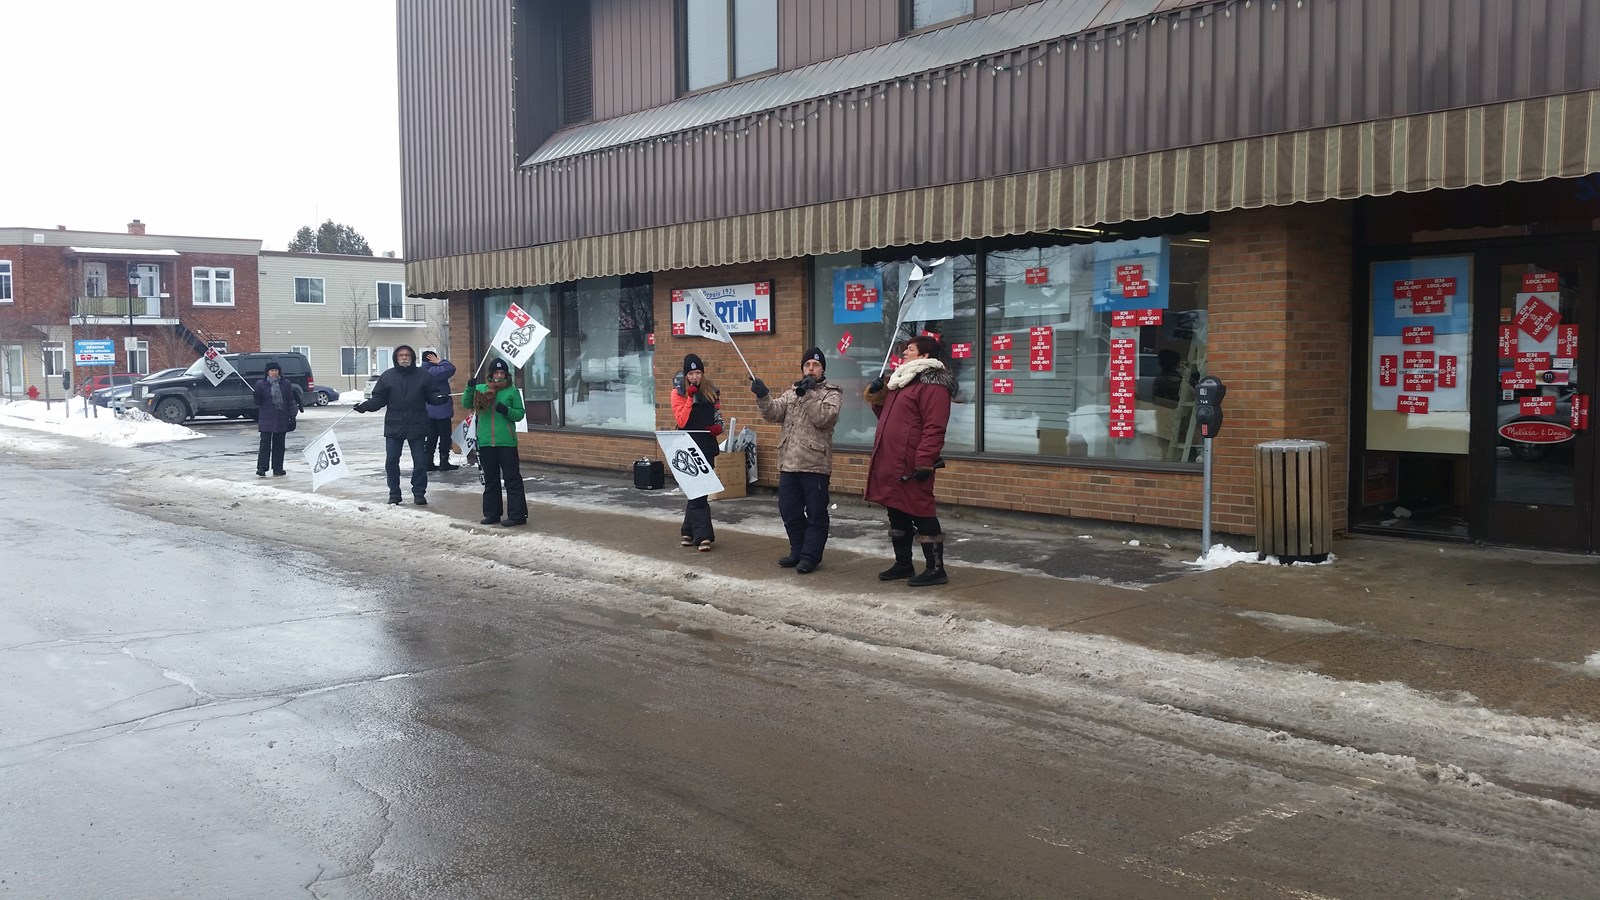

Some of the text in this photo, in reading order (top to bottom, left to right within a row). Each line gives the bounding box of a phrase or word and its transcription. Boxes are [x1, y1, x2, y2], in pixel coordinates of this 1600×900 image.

[703, 291, 720, 299] Depuis
[1518, 301, 1538, 325] LOCK-OUT
[1520, 305, 1529, 315] EN
[699, 318, 718, 334] CSN
[1533, 312, 1553, 335] LOCK-OUT
[1534, 316, 1544, 326] EN
[1499, 337, 1504, 347] EN
[1572, 336, 1577, 347] EN
[500, 340, 521, 359] CSN
[1381, 366, 1384, 375] EN
[1451, 367, 1456, 377] EN
[1506, 426, 1539, 436] Melissa
[1547, 429, 1566, 438] Doug
[325, 443, 341, 466] CSN
[687, 447, 710, 474] CSN
